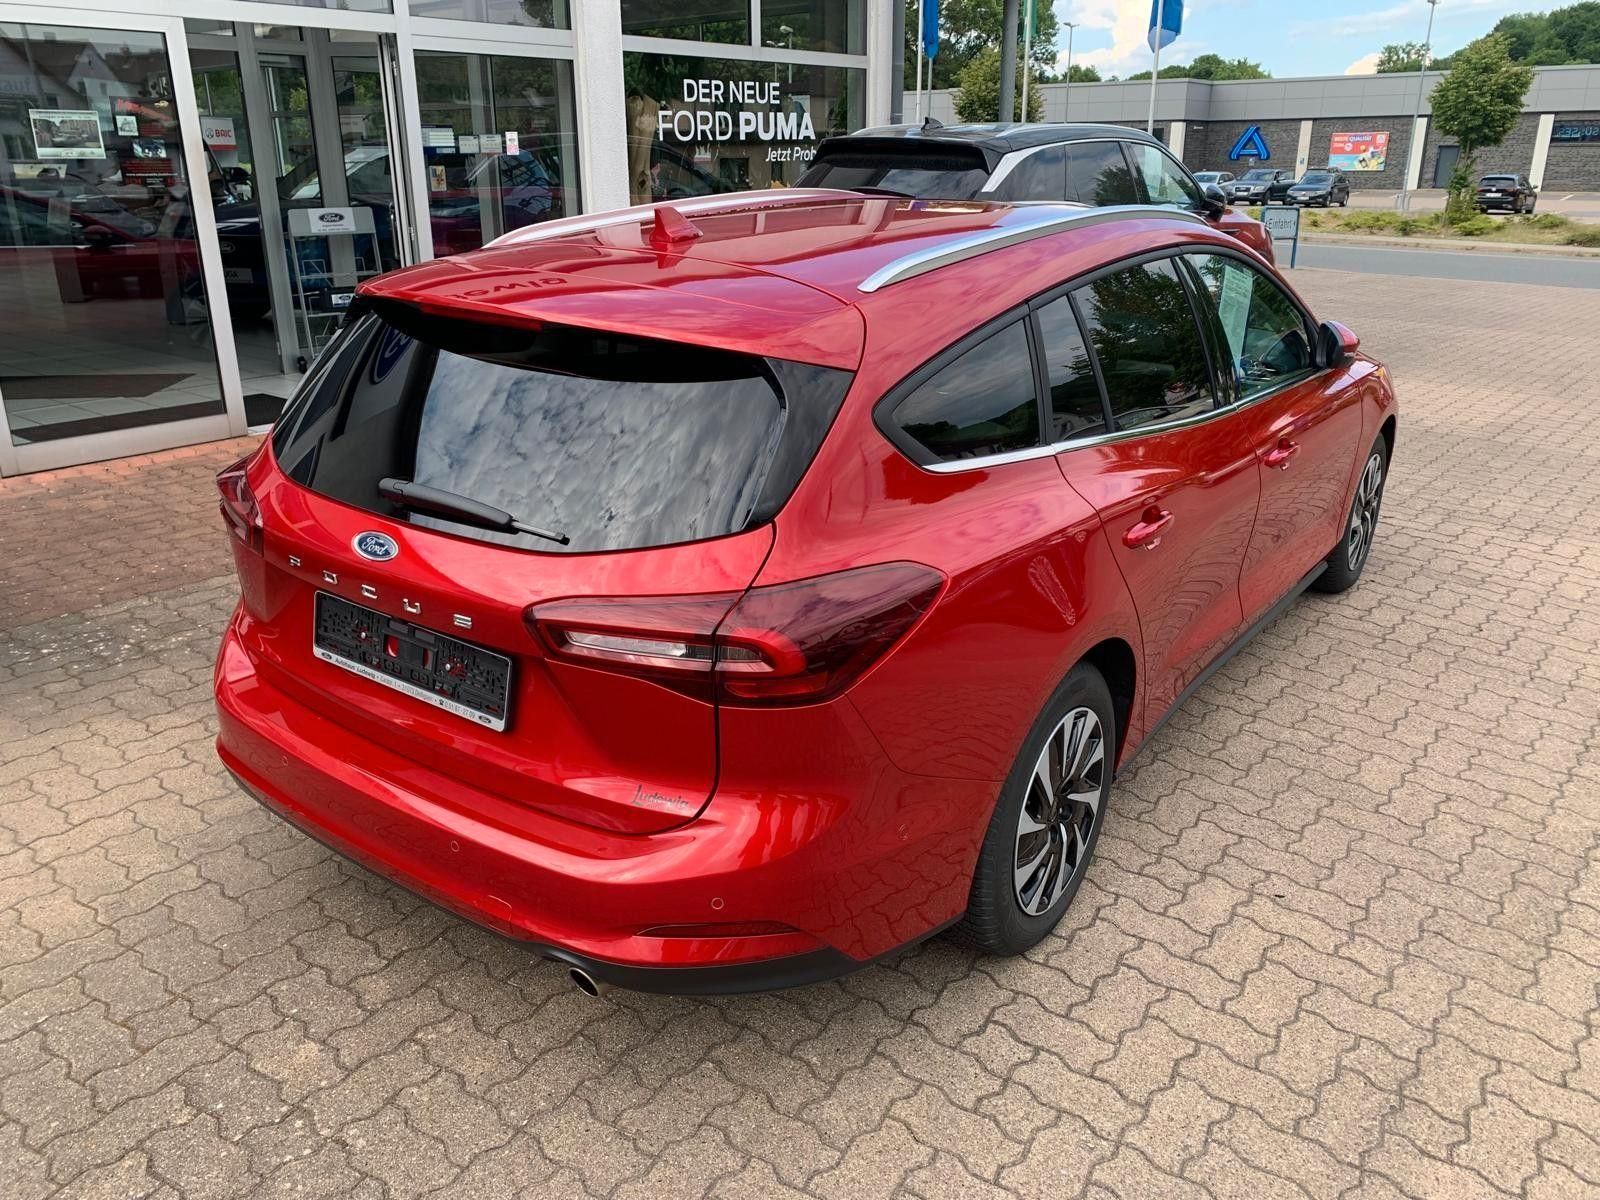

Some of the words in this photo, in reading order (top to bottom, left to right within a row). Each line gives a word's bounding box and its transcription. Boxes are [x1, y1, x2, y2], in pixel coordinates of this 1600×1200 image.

[683, 78, 724, 104] DER
[729, 80, 780, 105] NEUE
[658, 110, 733, 142] FORD
[739, 111, 816, 141] PUMA
[765, 147, 791, 162] Jetzt
[361, 536, 389, 556] Ford
[288, 555, 473, 629] FOCUS
